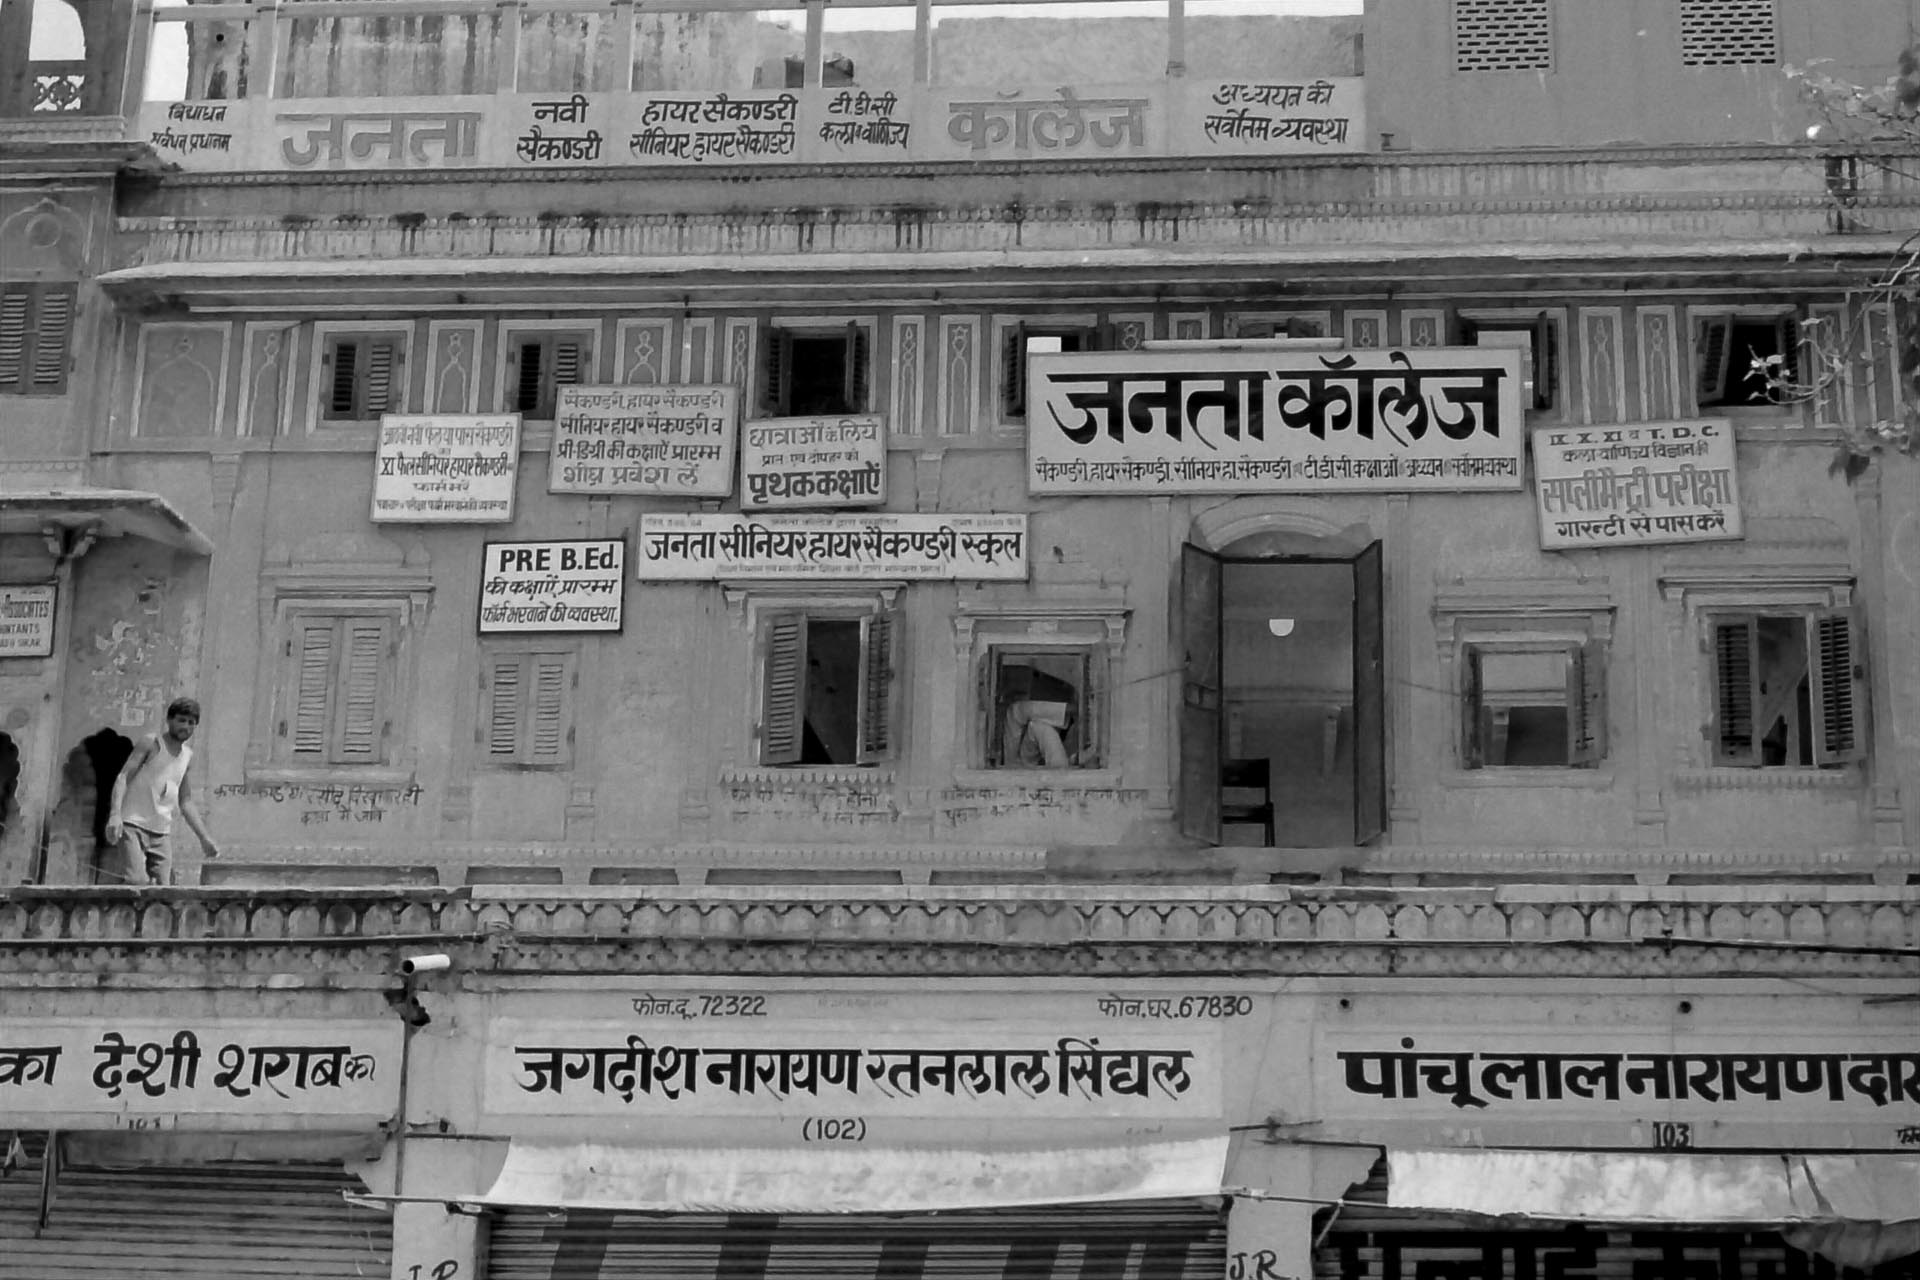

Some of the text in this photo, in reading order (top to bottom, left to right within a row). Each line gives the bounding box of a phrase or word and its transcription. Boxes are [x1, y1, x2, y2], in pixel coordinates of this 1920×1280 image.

[1307, 80, 1335, 105] की
[531, 94, 590, 123] नवी
[642, 100, 701, 126] हायर
[276, 112, 481, 166] जनता
[516, 124, 603, 164] सैकण्डरी
[693, 132, 736, 162] हायर
[1046, 350, 1507, 450] जनता कॉलेज
[1603, 430, 1622, 443] XI
[500, 543, 619, 573] PRE B.Ed.
[645, 531, 716, 562] जनता
[719, 523, 807, 563] सीनियर
[808, 531, 862, 564] हायर
[960, 531, 1023, 567] स्कूल
[485, 576, 508, 596] की
[93, 1029, 201, 1098] देशी
[213, 1043, 351, 1099] शराब
[343, 1054, 376, 1082] का
[512, 1034, 701, 1104] जगदीश
[702, 1048, 863, 1102] नारायण
[802, 1116, 866, 1142] (102)
[1653, 1121, 1692, 1148] 103
